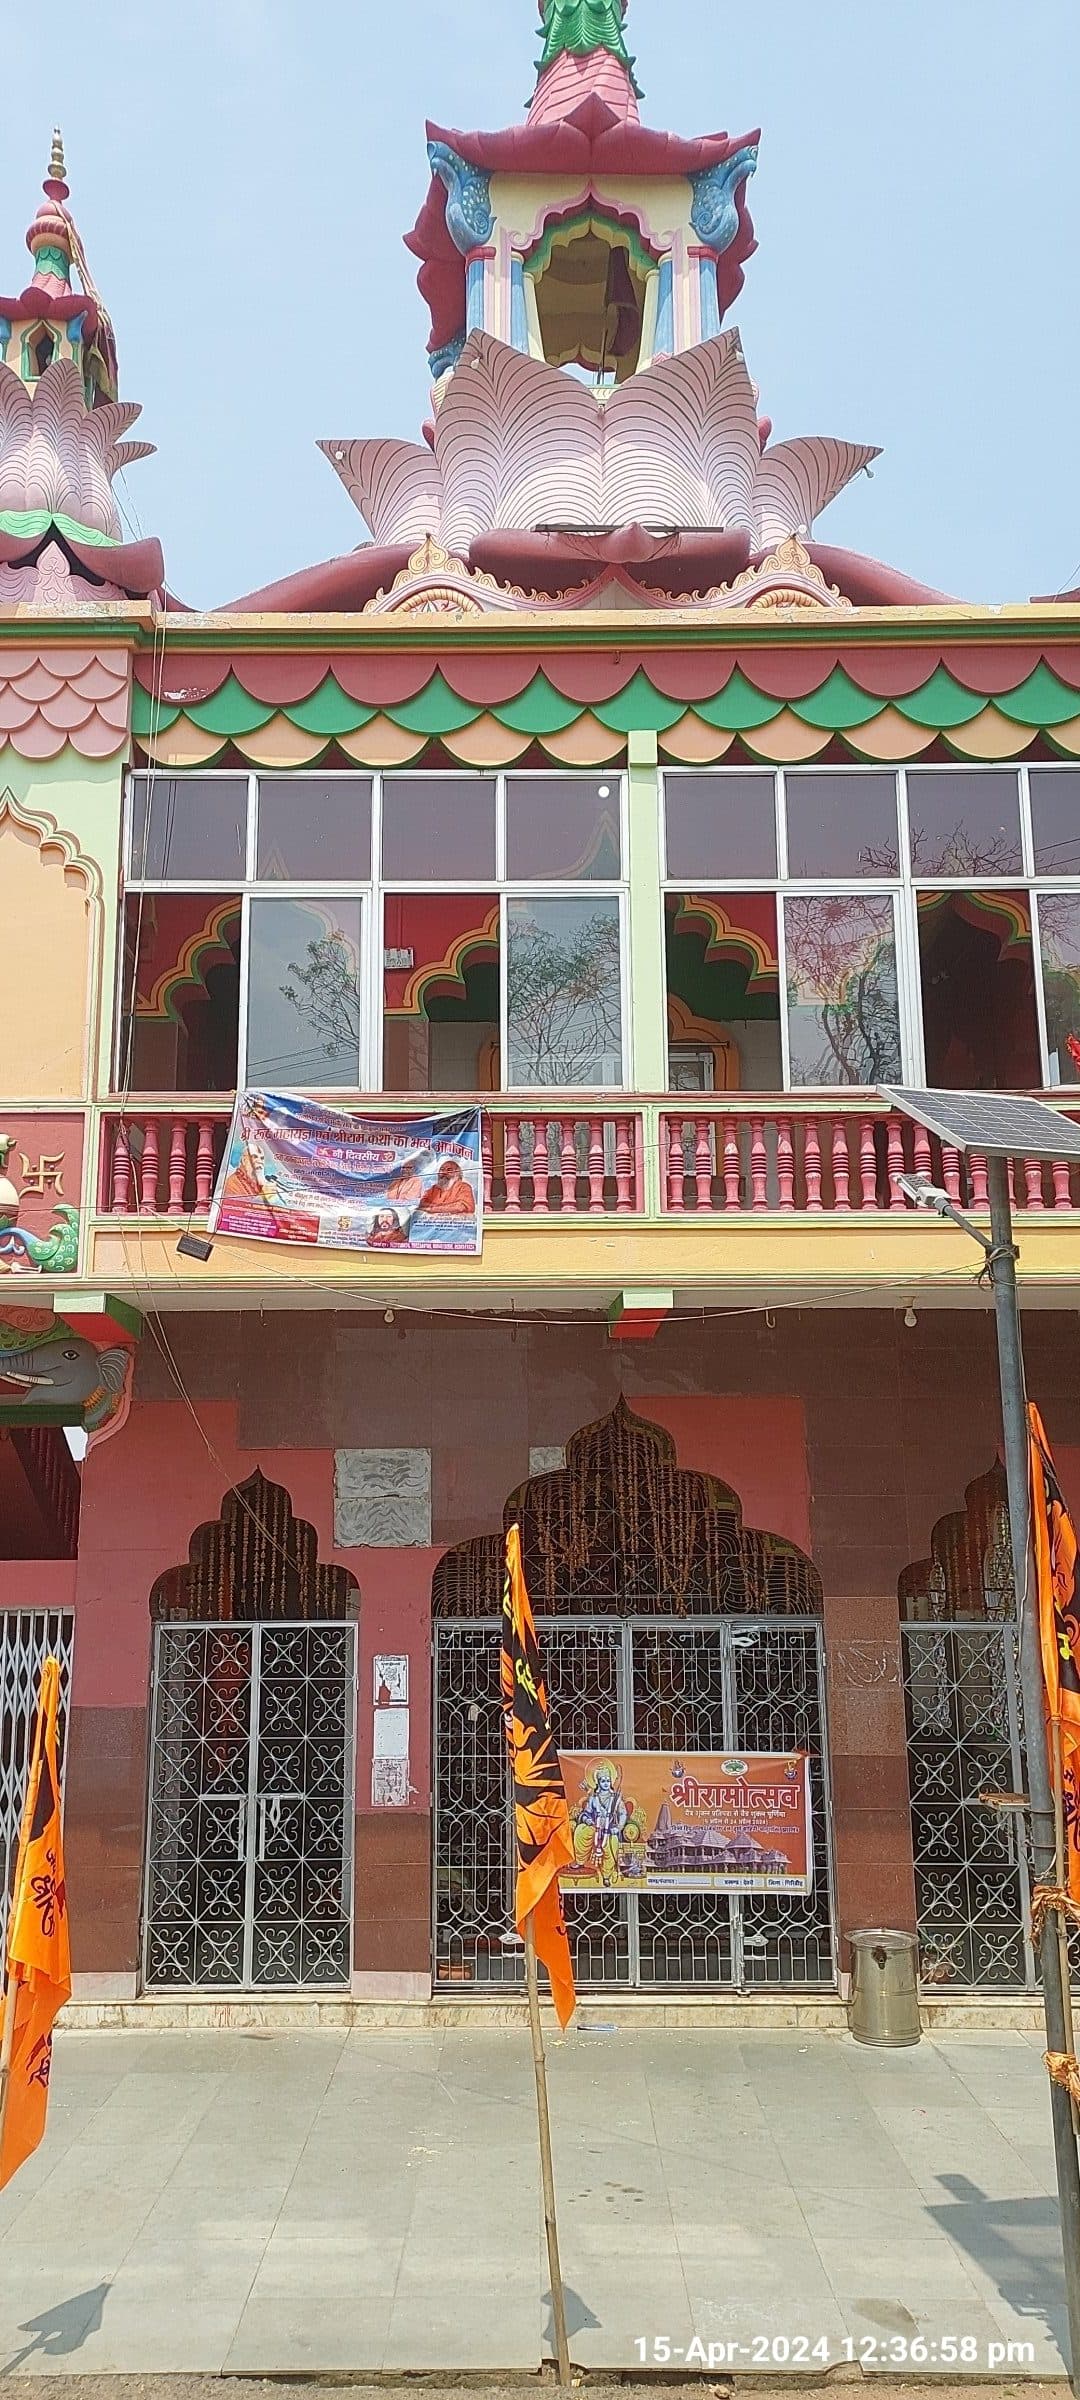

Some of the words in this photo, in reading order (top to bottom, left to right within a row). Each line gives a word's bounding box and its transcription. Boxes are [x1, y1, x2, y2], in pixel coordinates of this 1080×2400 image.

[368, 1133, 391, 1147] कथा
[393, 1135, 409, 1149] का
[411, 1137, 431, 1151] भव्य
[345, 1149, 381, 1162] दिवसीय
[670, 1776, 800, 1809] श्रीरामोत्सव
